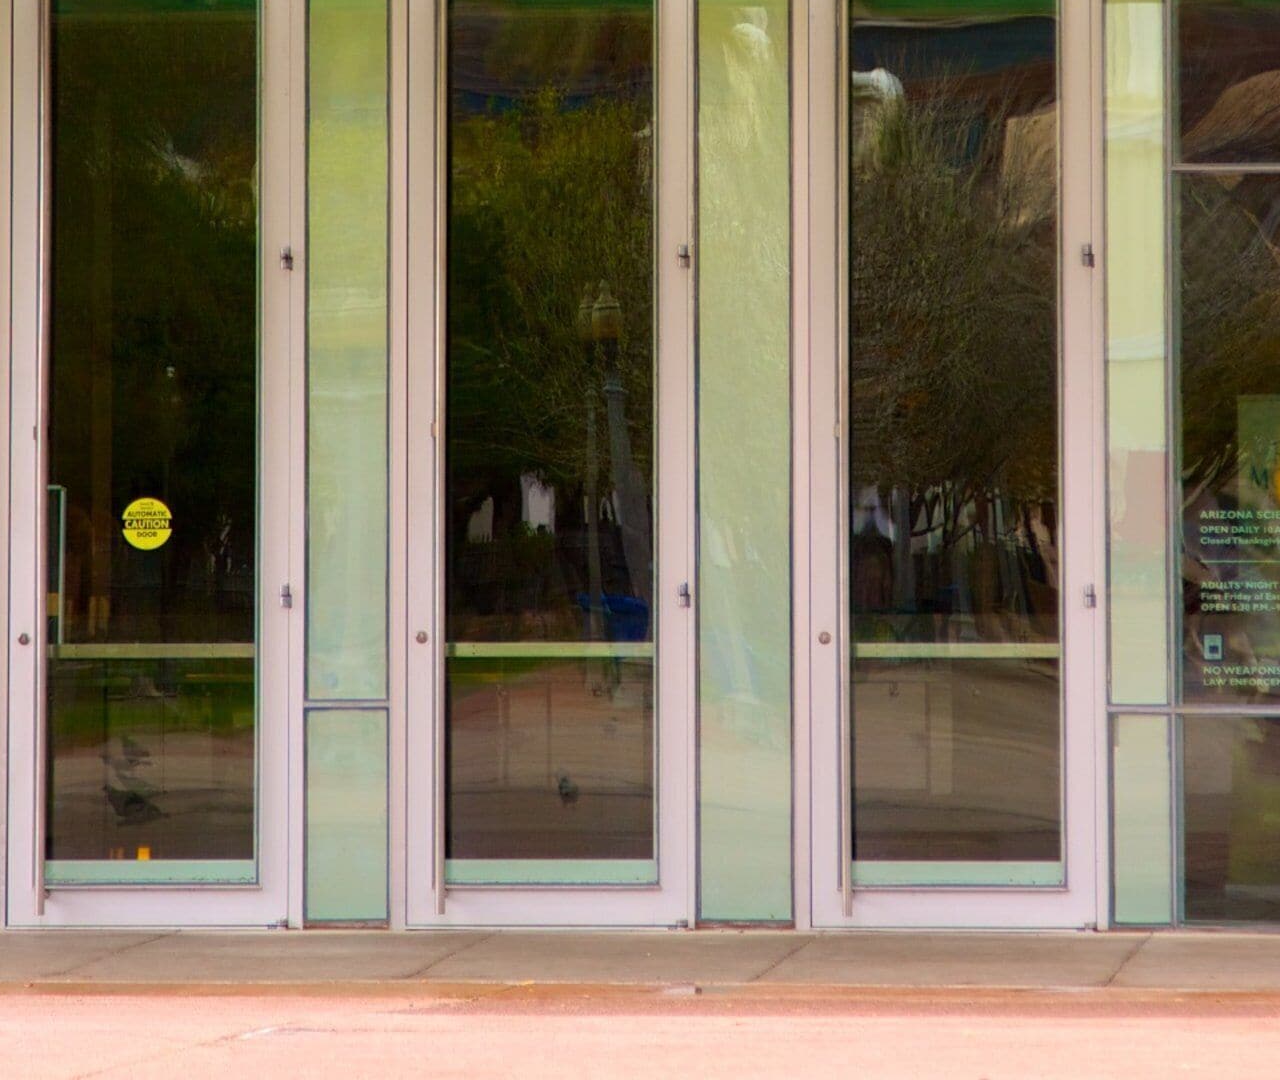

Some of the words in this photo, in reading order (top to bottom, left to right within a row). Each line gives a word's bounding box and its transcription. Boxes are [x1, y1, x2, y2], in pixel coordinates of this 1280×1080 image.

[1200, 510, 1254, 520] ARIZONA
[124, 519, 170, 529] CAUTION
[1200, 526, 1229, 534] OPEN
[1231, 526, 1261, 534] DAILY
[1200, 537, 1231, 545] Closed
[1246, 581, 1279, 590] NIGHT
[1201, 593, 1221, 601] First
[1224, 593, 1251, 603] Friday
[1253, 593, 1264, 601] of
[1201, 604, 1229, 612] OPEN
[1203, 667, 1221, 676] NO
[1203, 678, 1227, 687] LAW
